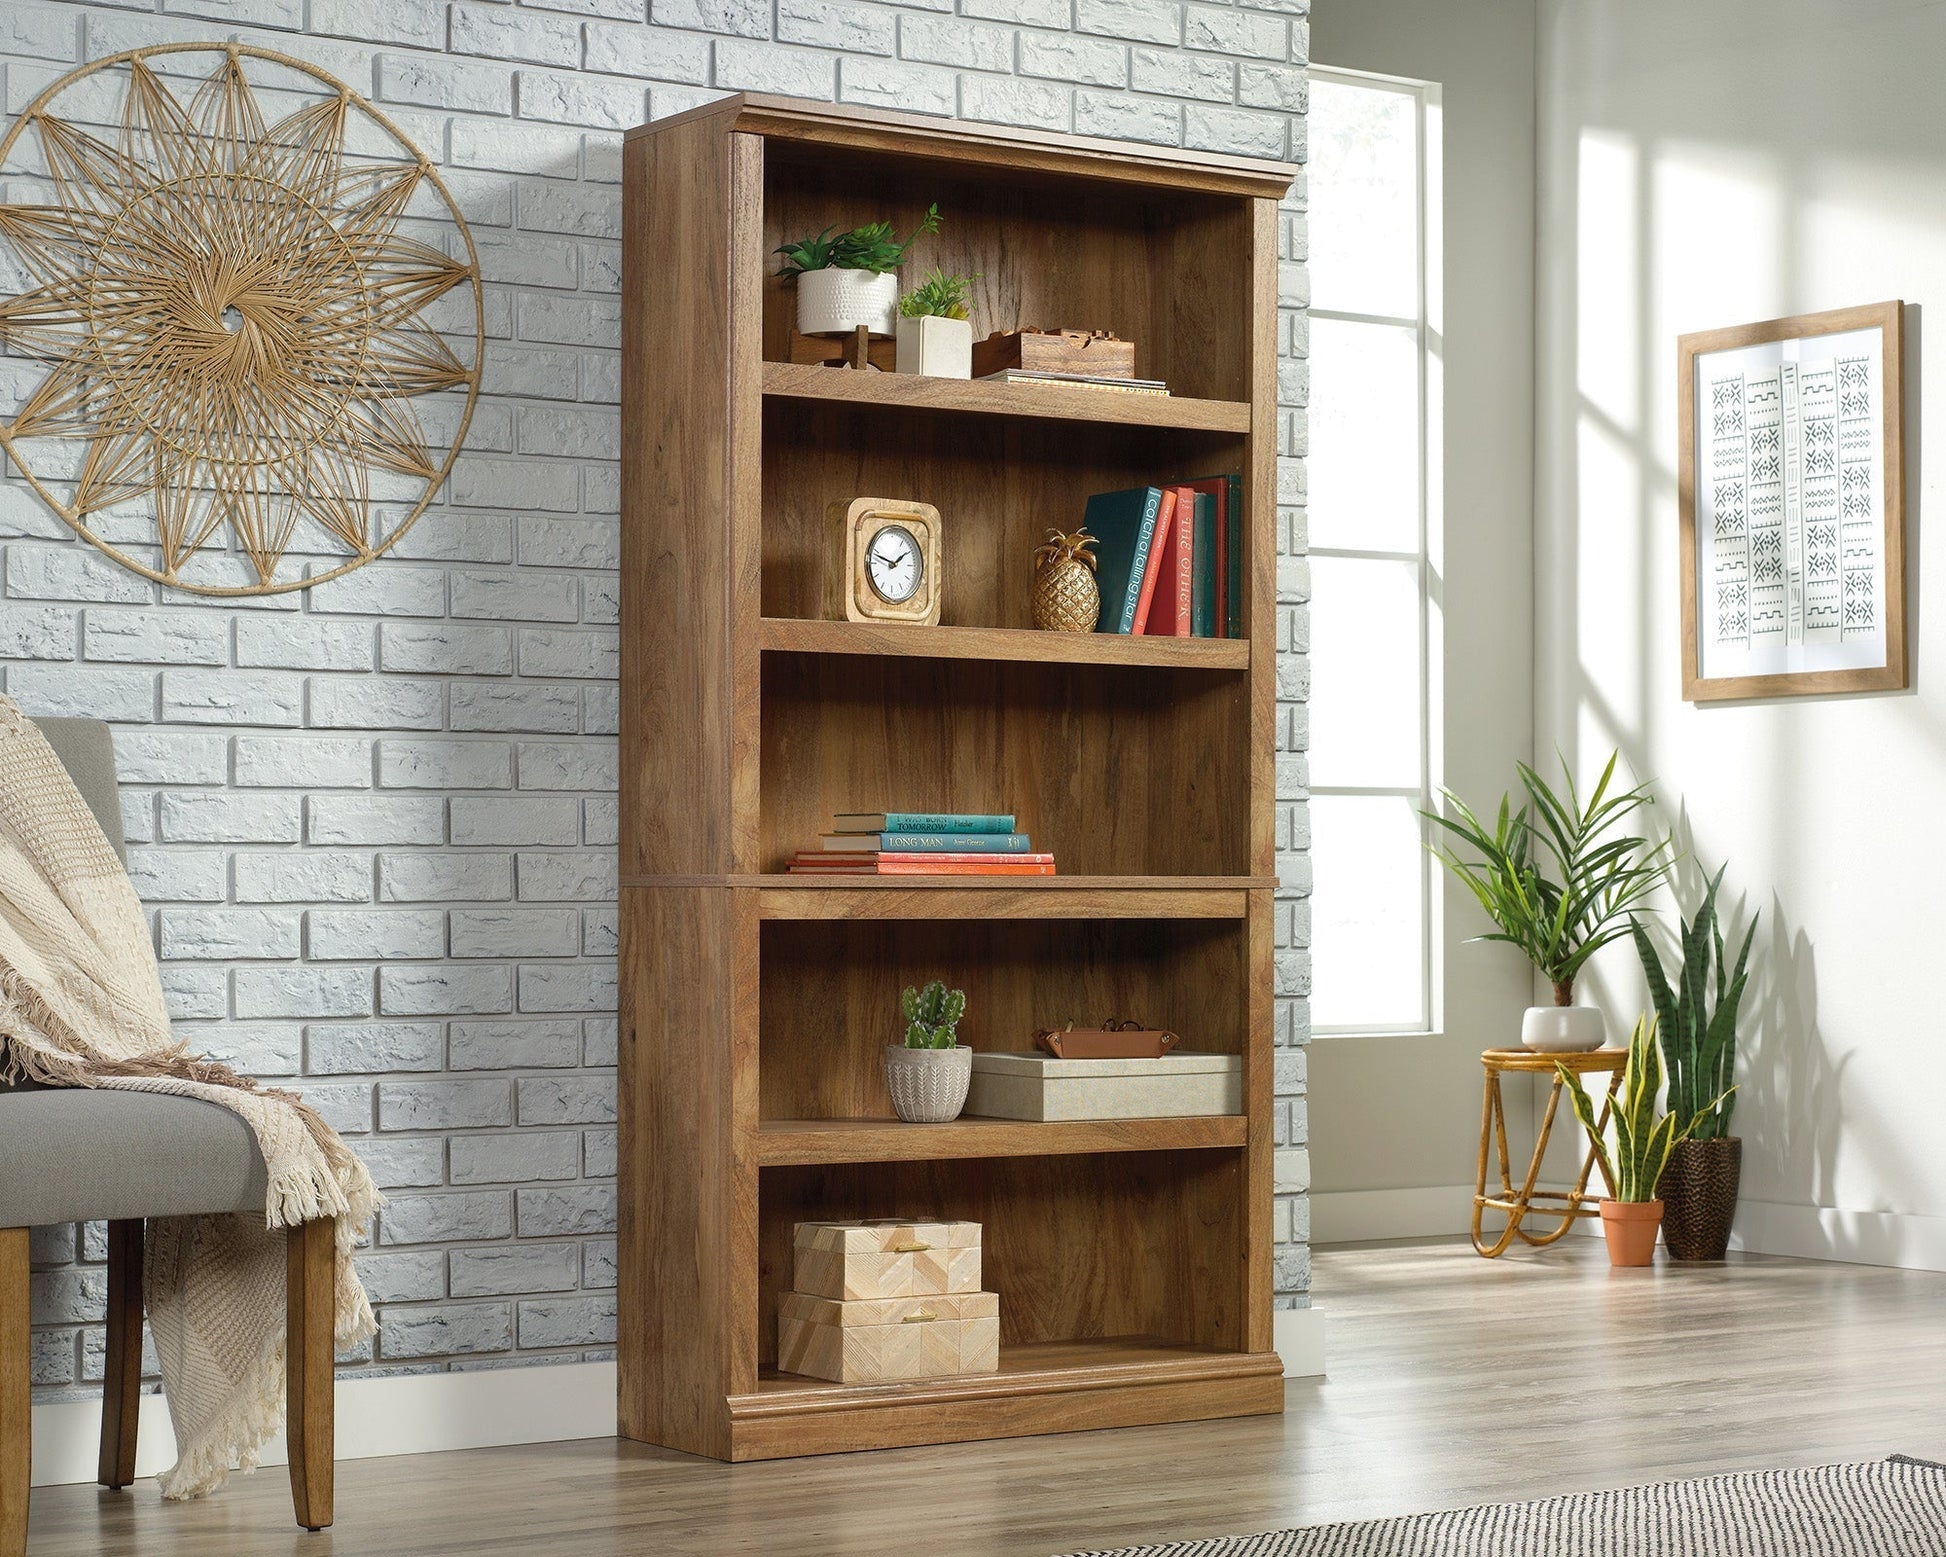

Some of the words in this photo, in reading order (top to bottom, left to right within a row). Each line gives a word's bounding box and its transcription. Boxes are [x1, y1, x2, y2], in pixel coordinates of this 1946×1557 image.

[1141, 499, 1158, 540] catch
[1180, 517, 1192, 550] THE
[1138, 541, 1149, 551] a
[1128, 553, 1147, 595] falling
[1178, 558, 1191, 621] OTHER
[1124, 595, 1138, 622] star
[889, 837, 918, 847] LONG
[920, 837, 944, 847] MAN
[897, 823, 947, 831] TOMORROW
